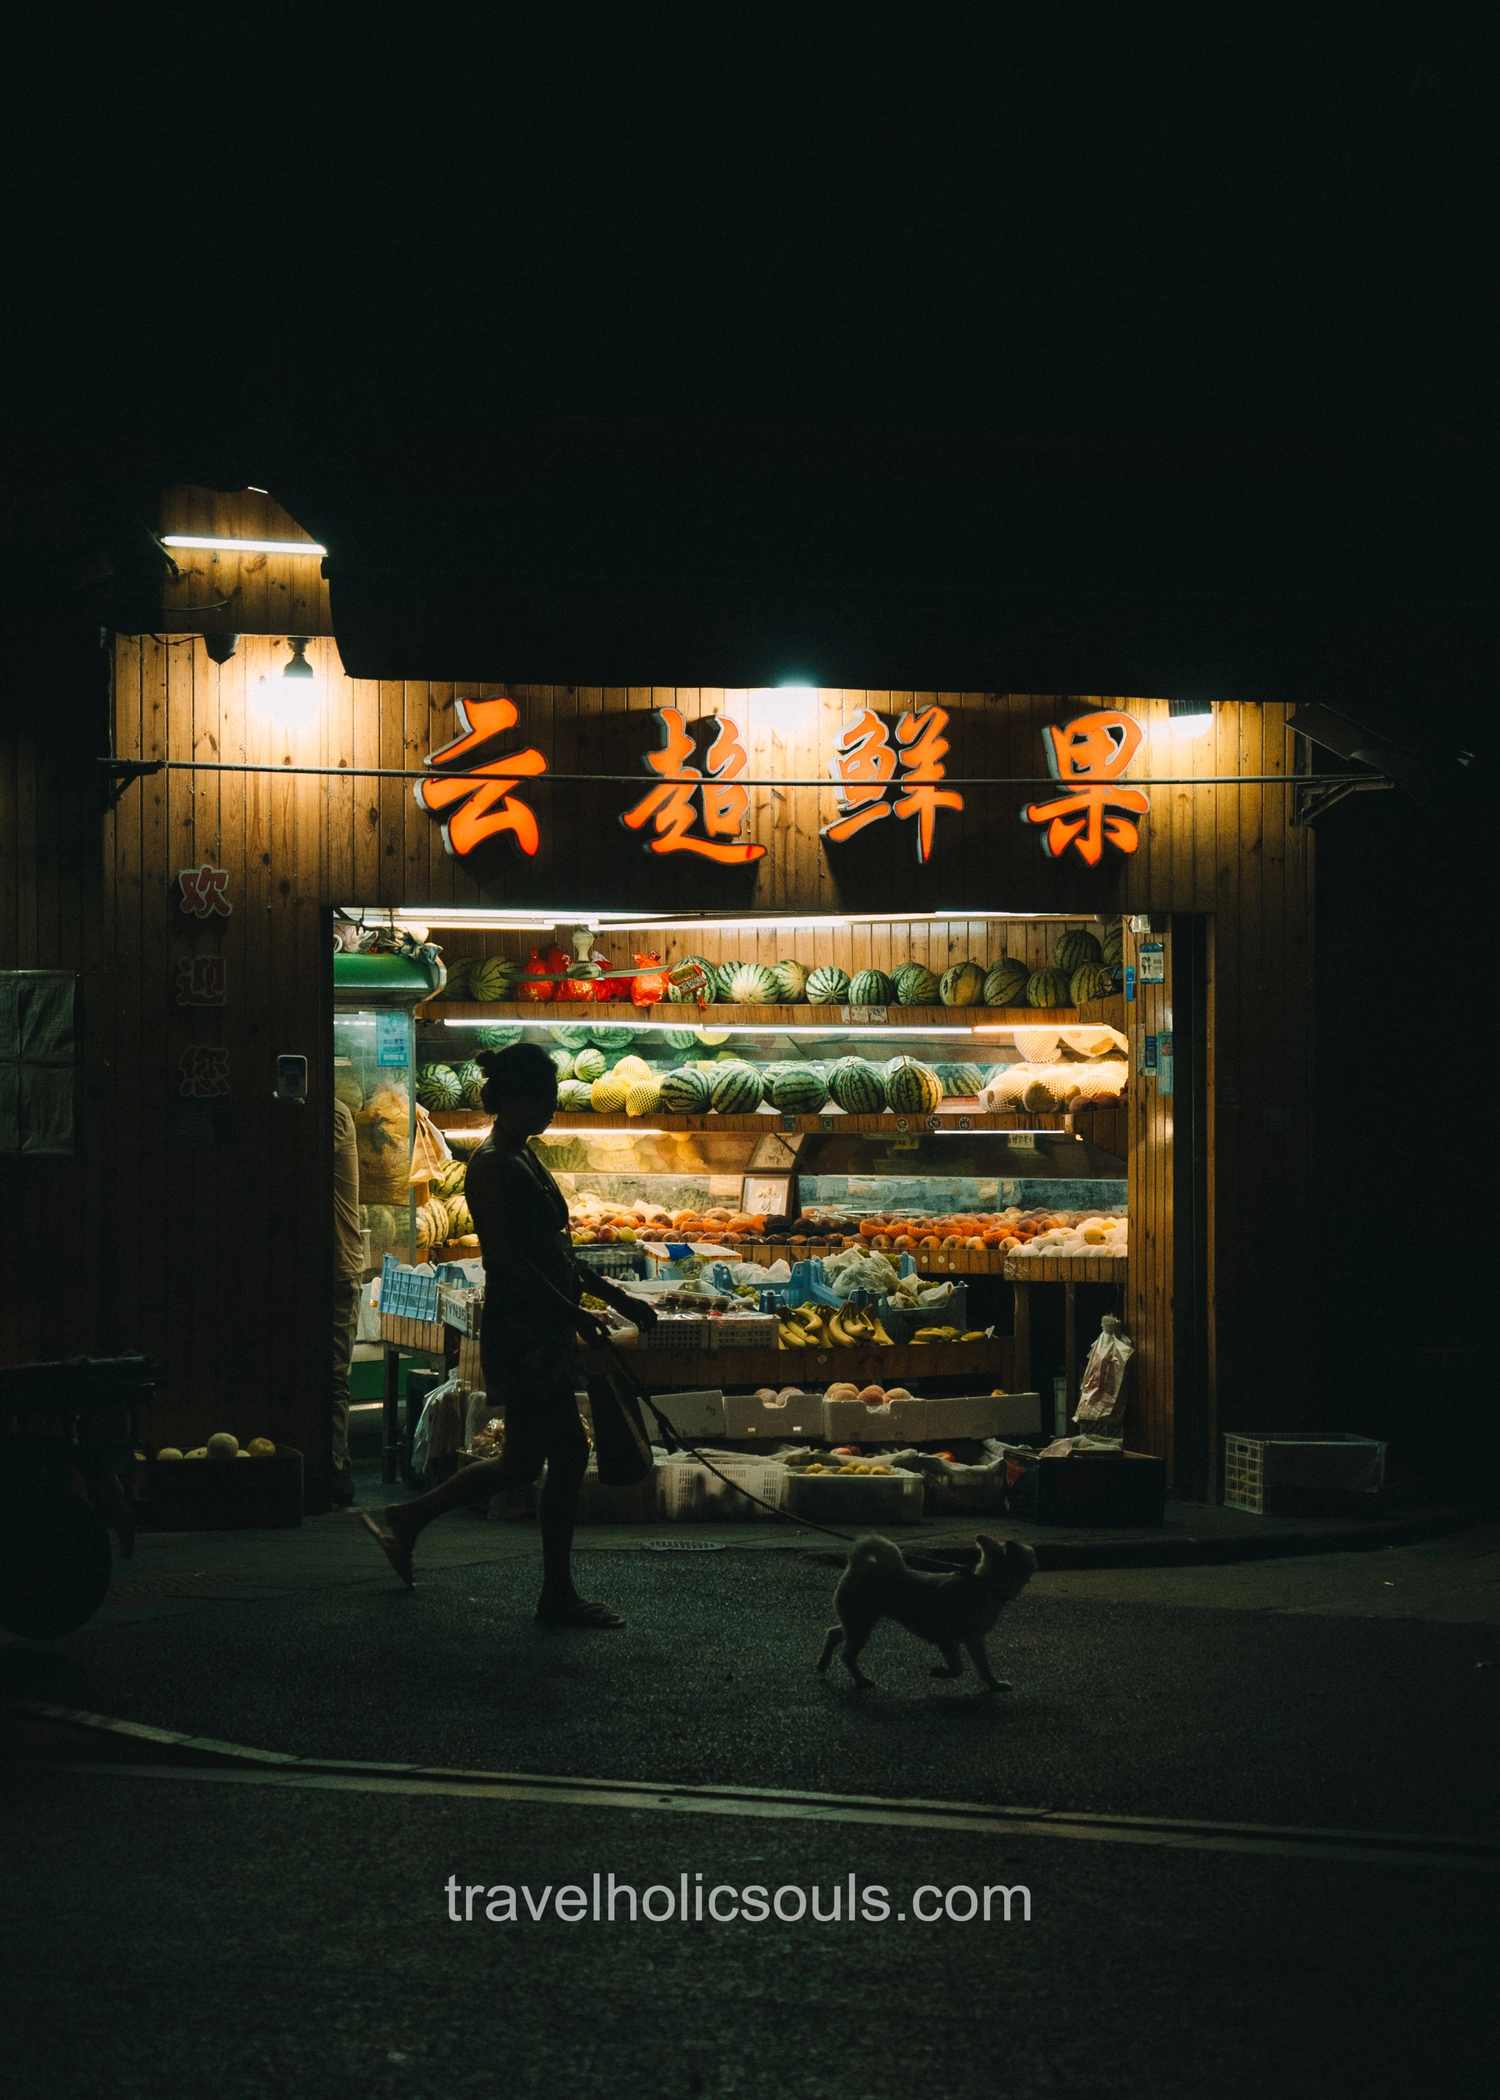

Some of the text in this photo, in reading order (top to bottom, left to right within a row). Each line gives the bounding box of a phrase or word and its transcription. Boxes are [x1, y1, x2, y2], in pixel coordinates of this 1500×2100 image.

[414, 697, 1150, 867] 云超鲜果
[176, 864, 233, 1097] 欢迎您
